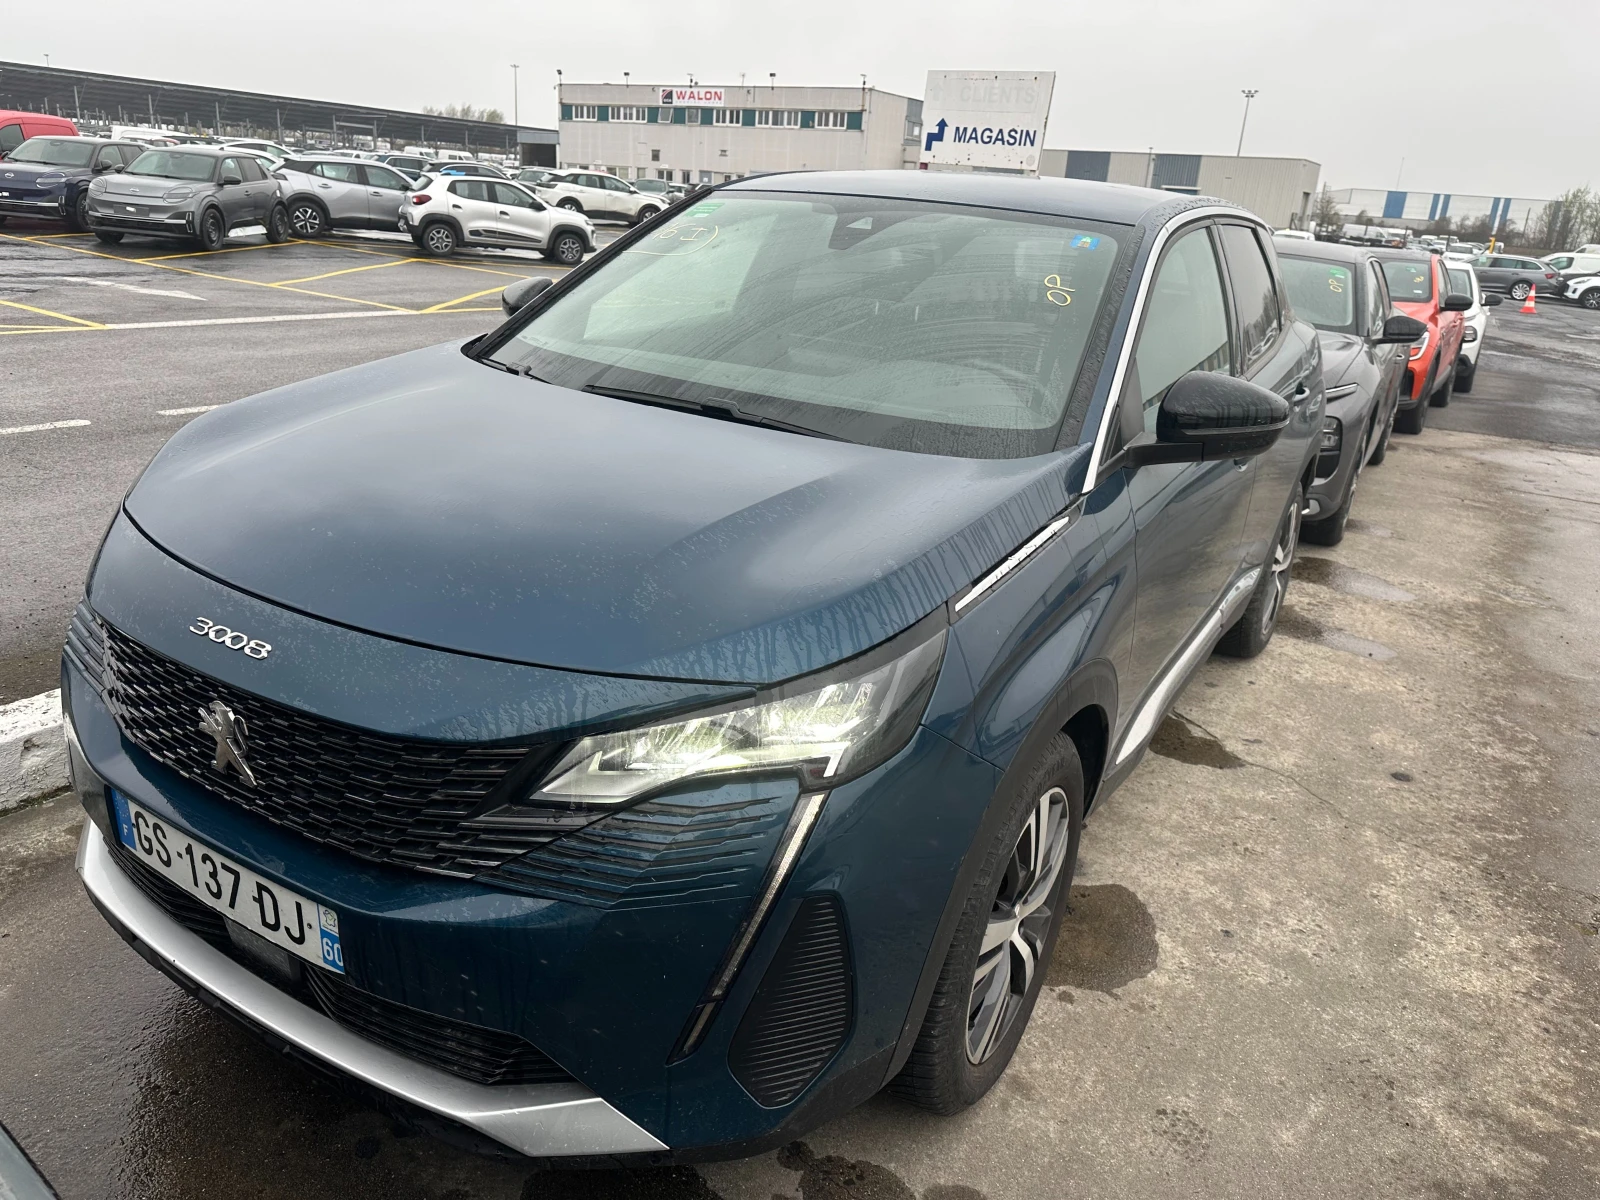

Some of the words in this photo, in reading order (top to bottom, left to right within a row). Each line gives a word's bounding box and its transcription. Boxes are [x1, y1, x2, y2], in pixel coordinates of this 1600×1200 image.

[675, 90, 723, 101] WALON
[960, 85, 1036, 104] CLIENTS
[953, 126, 1037, 147] MAGASIN
[189, 616, 272, 660] 3008
[122, 823, 129, 836] F
[322, 937, 344, 967] 60
